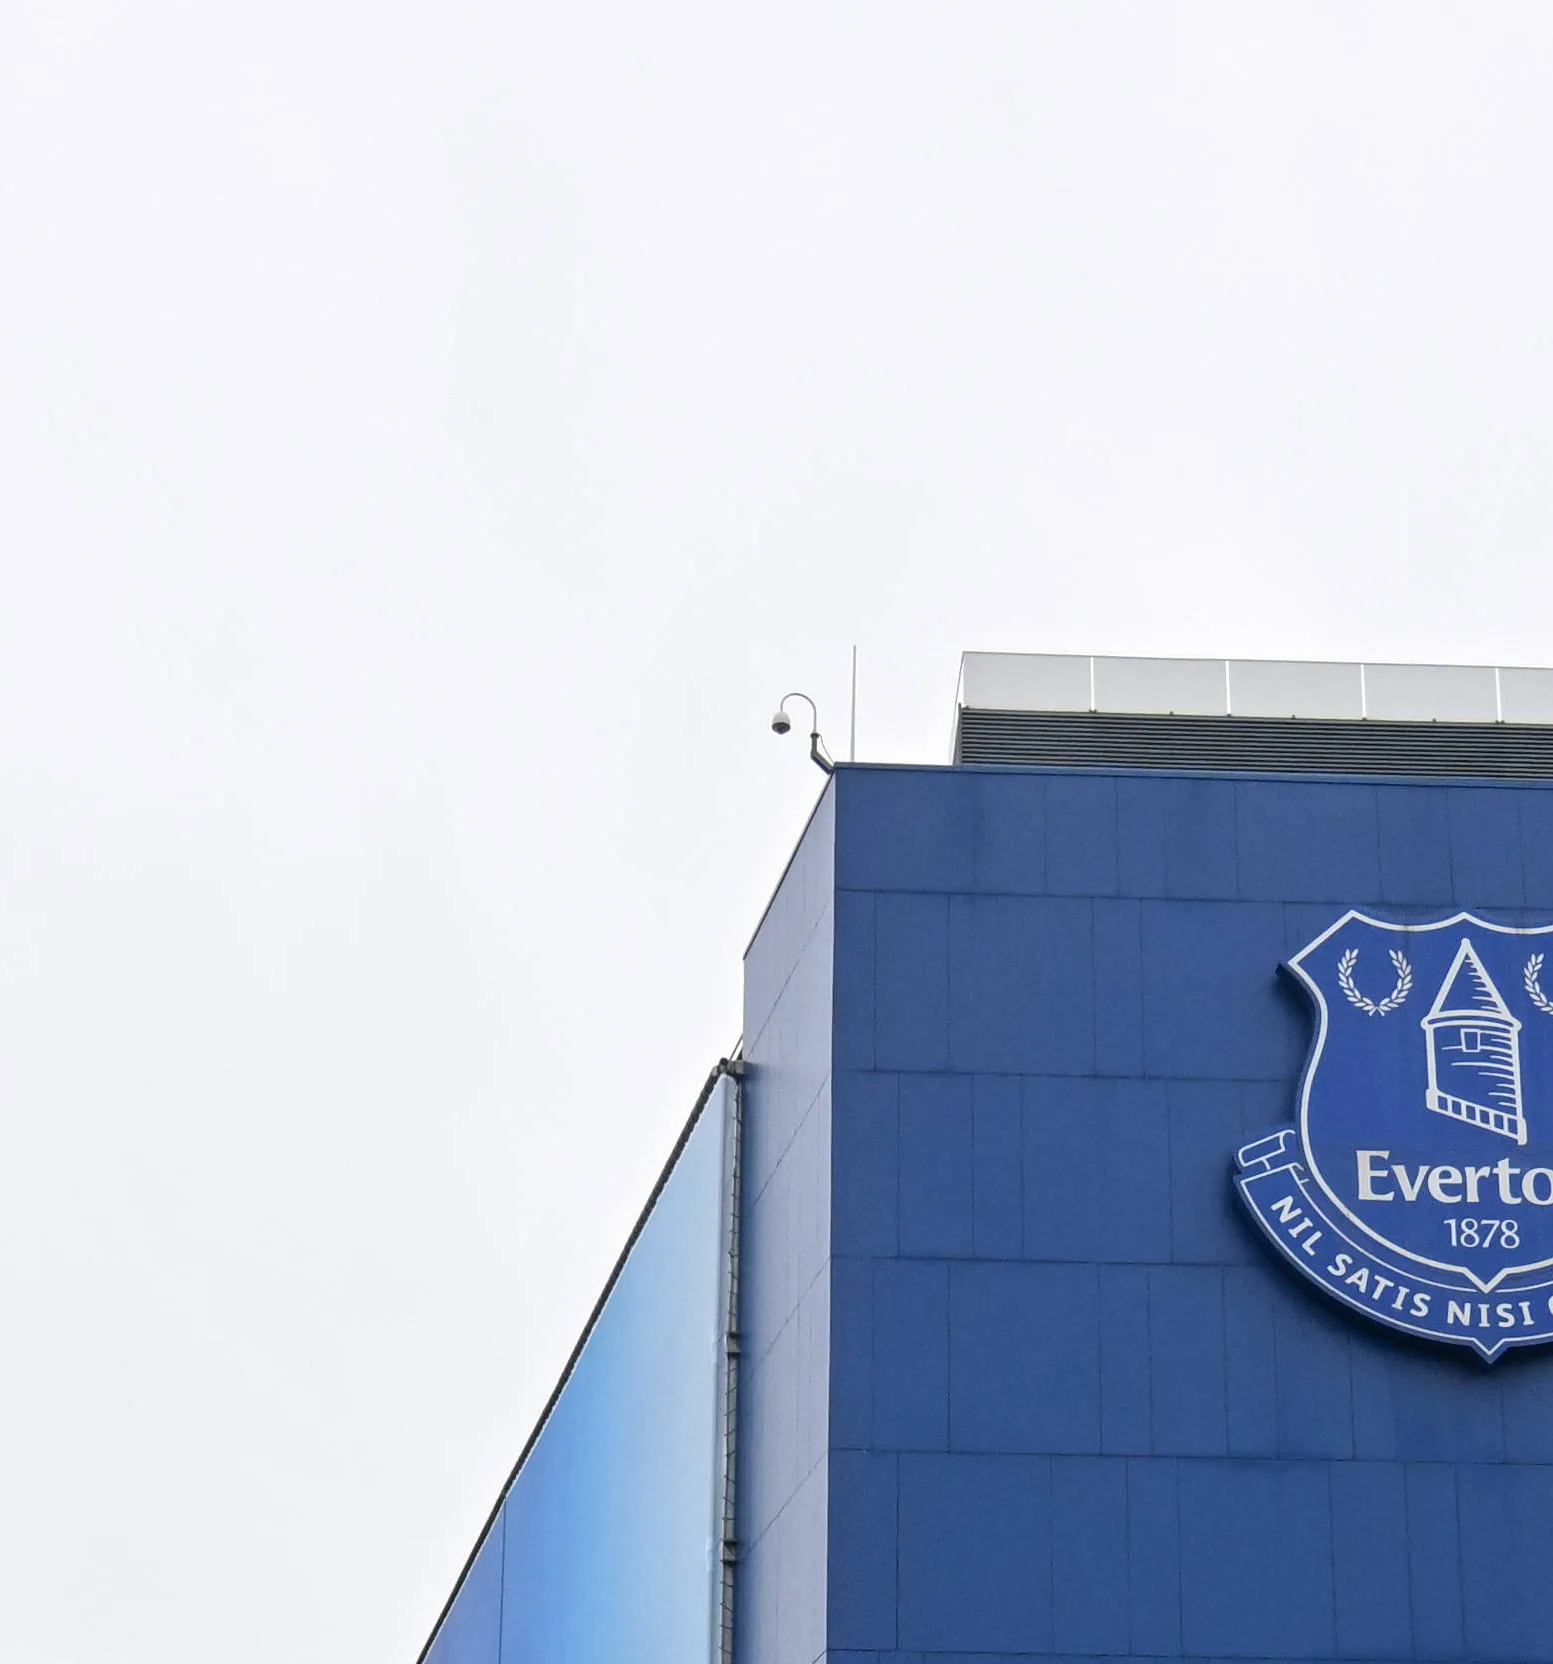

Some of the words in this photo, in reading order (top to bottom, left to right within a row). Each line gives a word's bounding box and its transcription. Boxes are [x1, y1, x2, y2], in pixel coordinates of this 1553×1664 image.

[1270, 1195, 1324, 1257] NIL
[1326, 1252, 1431, 1318] SATIS
[1447, 1300, 1535, 1328] NISI
[1443, 1218, 1521, 1249] 1878
